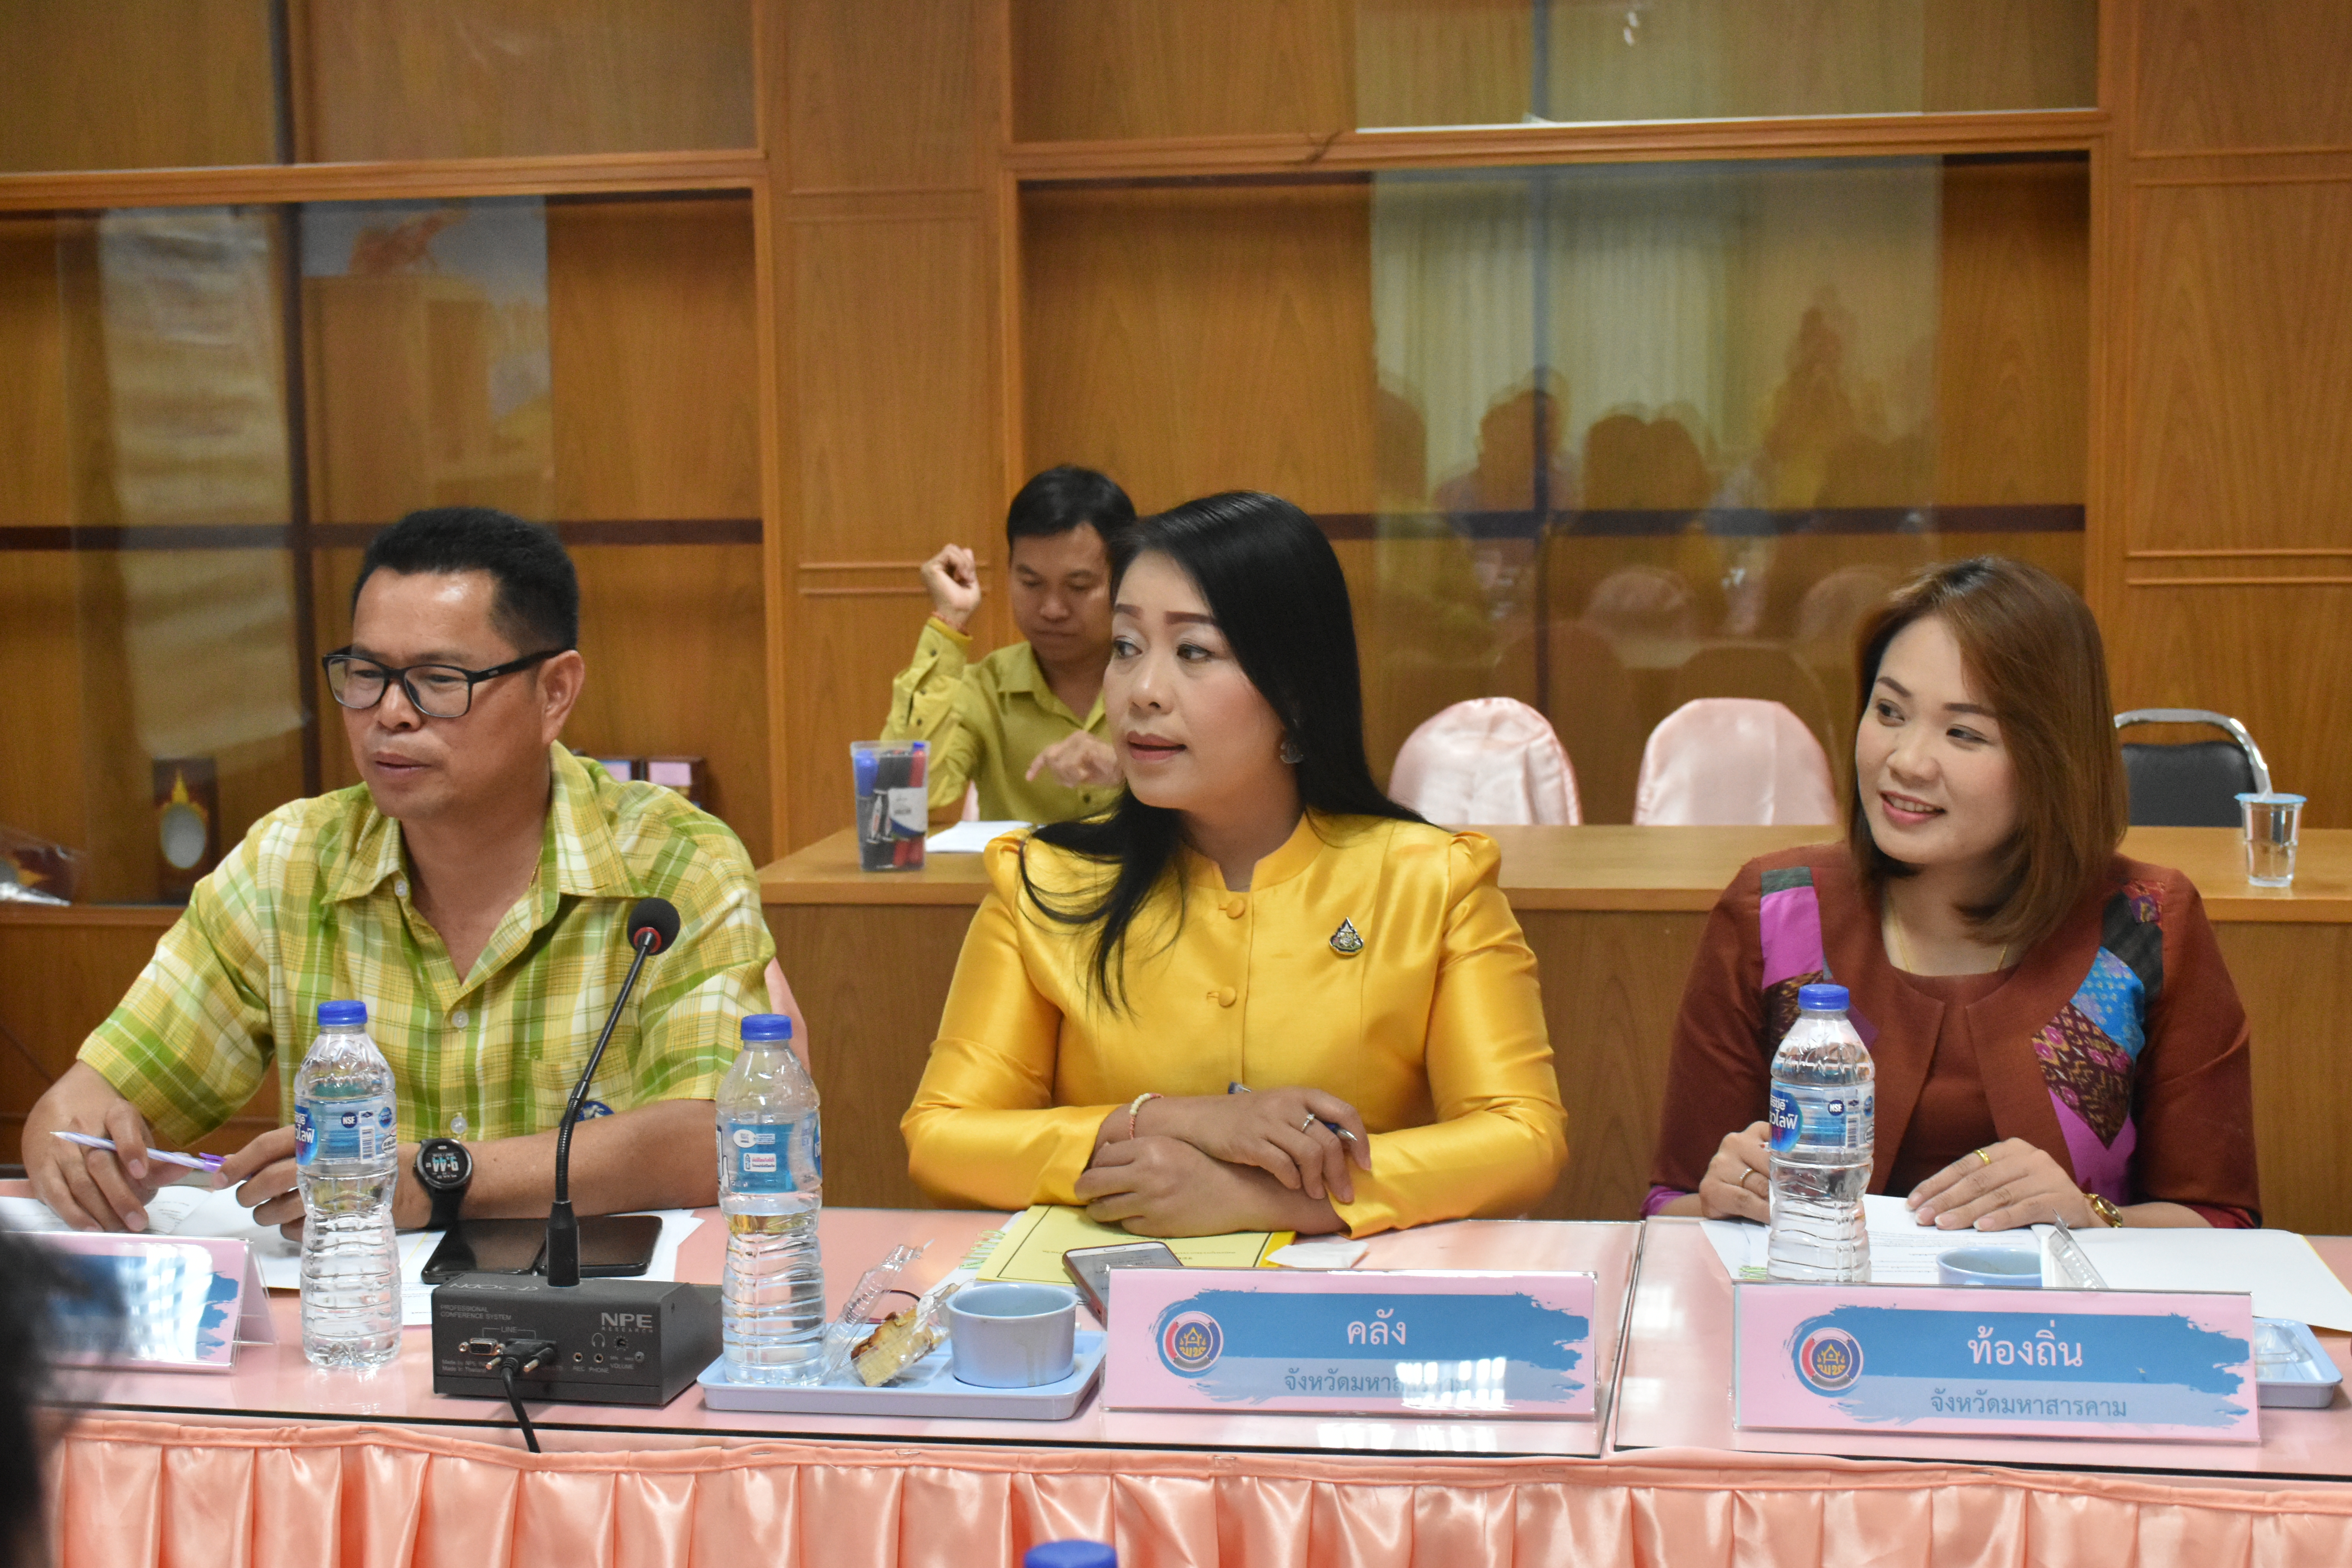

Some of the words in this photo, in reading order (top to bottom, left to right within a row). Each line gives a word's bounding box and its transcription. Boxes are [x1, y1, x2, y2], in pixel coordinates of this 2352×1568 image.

[440, 1304, 488, 1312] PROFESSIONAL
[601, 1312, 653, 1328] NPE
[1347, 1308, 1406, 1345] คลัง
[1968, 1319, 2083, 1367] ท้องถิ่น
[1931, 1388, 2127, 1417] จังหวัดมหาสารคาม
